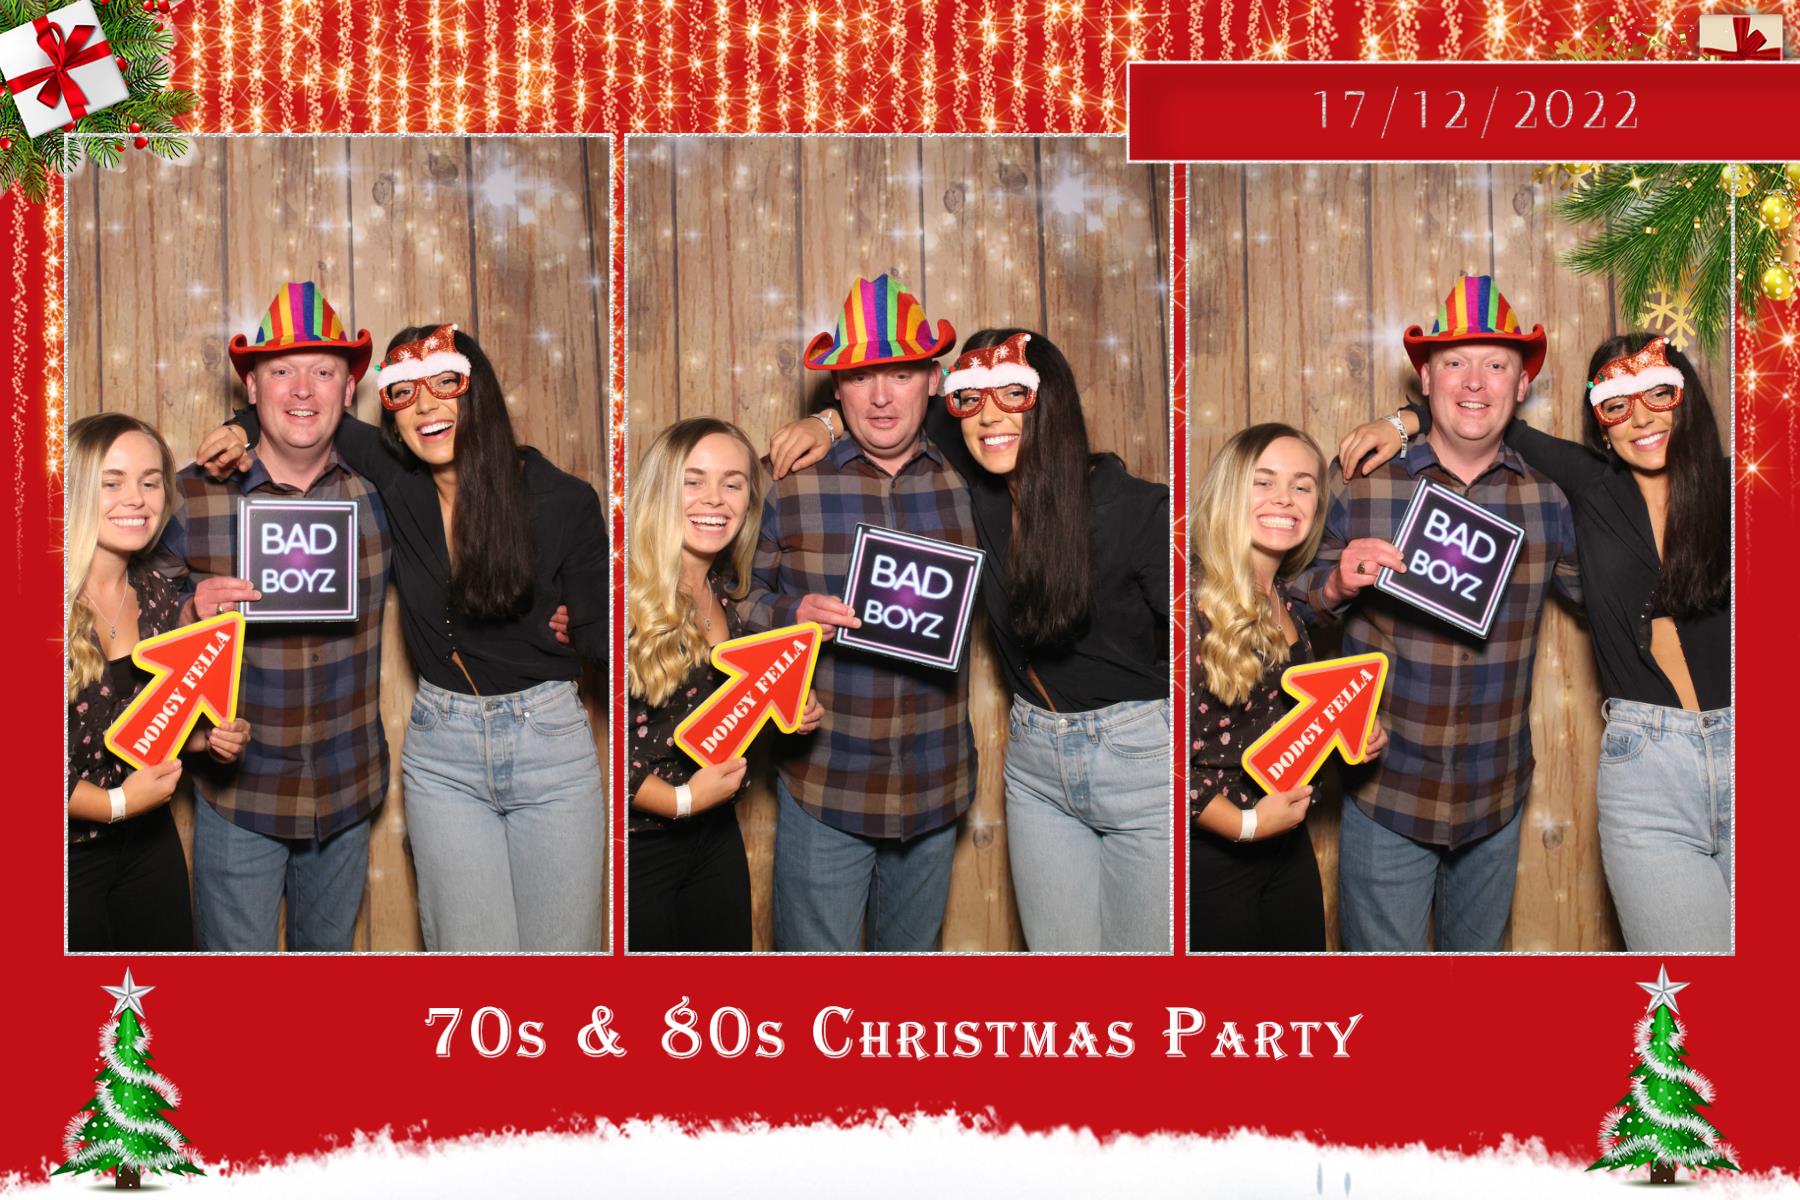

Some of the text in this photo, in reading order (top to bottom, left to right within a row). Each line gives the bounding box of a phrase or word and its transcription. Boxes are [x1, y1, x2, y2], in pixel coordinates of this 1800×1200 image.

[262, 523, 337, 555] BAD
[1424, 508, 1497, 564] BAD
[262, 568, 336, 593] BOYZ
[870, 554, 953, 600] BAD
[1409, 549, 1483, 602] BOYZ
[863, 599, 944, 639] BOYZ
[132, 630, 231, 756] DODGY FELLA
[700, 639, 808, 754] DODGY FELLA
[1267, 668, 1374, 781] DODGY FELLA
